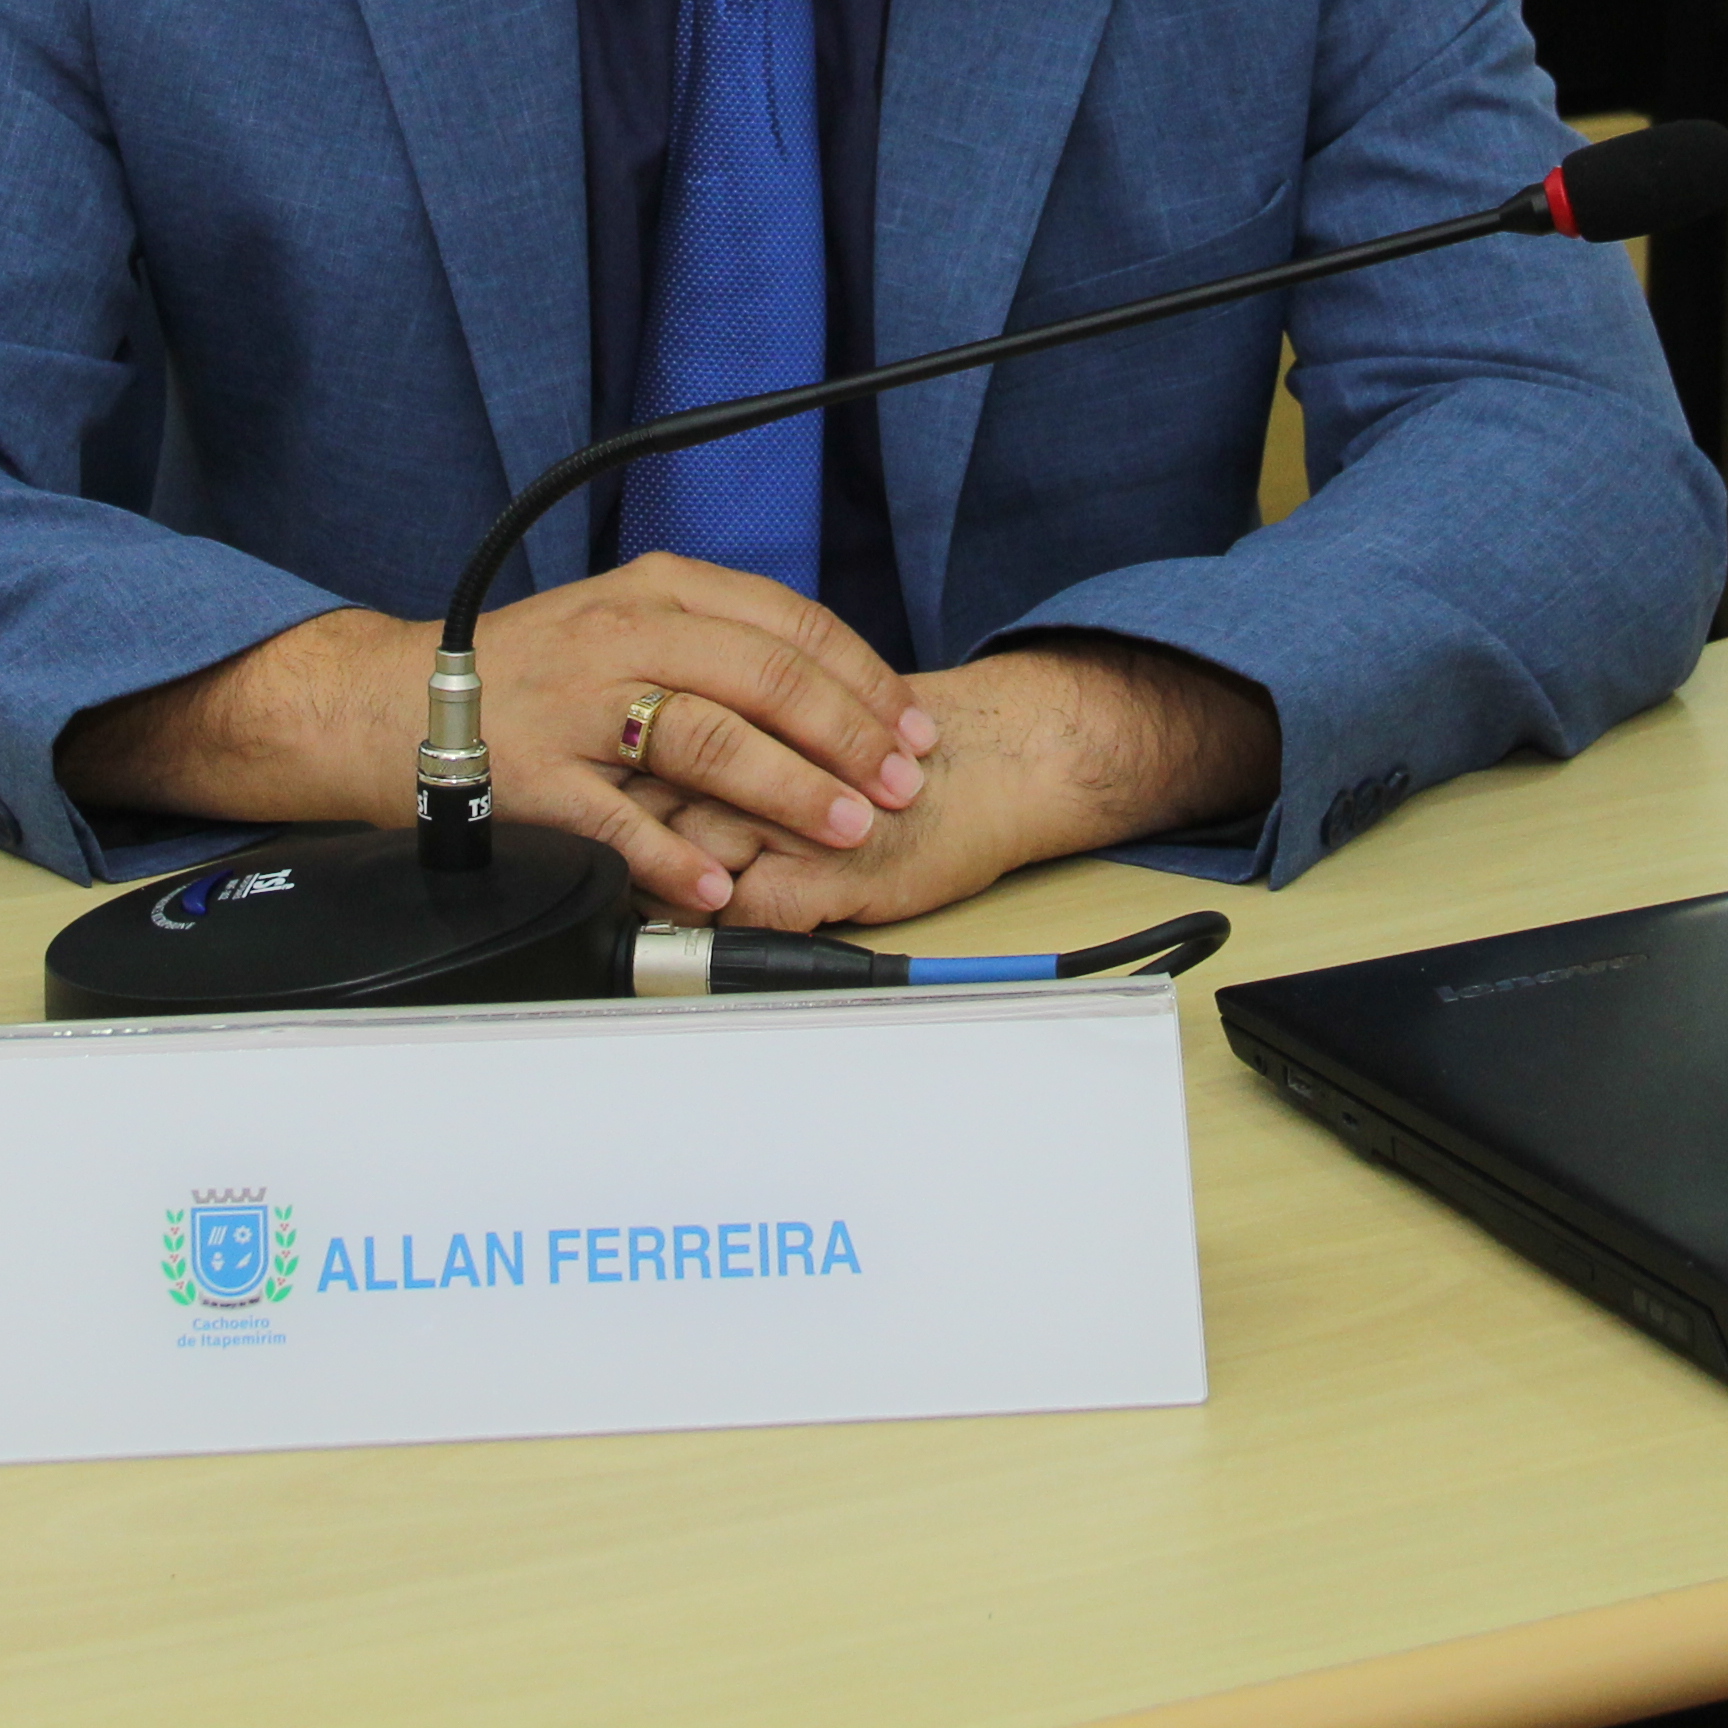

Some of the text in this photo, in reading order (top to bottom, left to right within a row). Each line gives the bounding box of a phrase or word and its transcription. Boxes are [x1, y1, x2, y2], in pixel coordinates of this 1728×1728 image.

[316, 1220, 863, 1293] ALLAN FERREIRA
[192, 1315, 270, 1331] Cachoeiro
[177, 1332, 287, 1348] de Itapemirim
